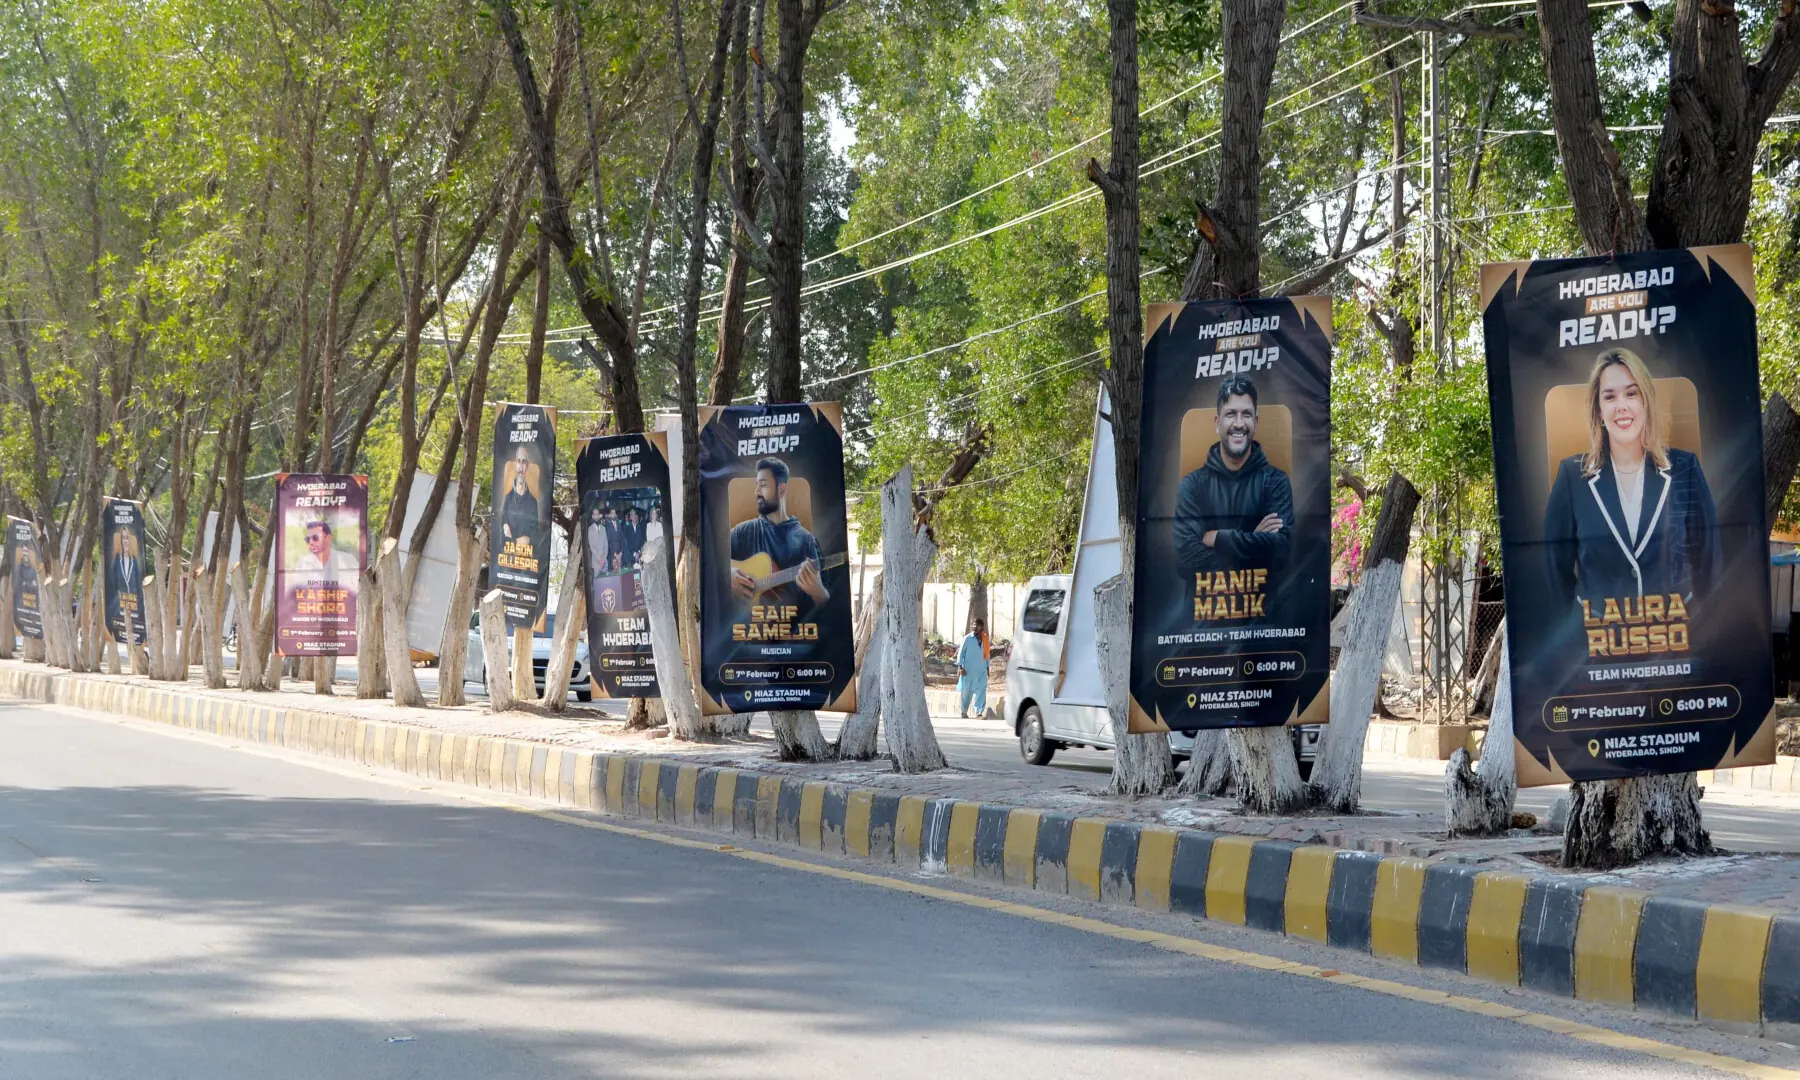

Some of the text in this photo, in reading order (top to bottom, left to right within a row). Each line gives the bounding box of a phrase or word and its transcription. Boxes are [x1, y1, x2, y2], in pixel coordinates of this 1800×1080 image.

[1559, 267, 1674, 299] HYDERABAD
[1589, 293, 1643, 312] ARE YOU
[1199, 315, 1280, 340] HYDERABAD
[1559, 305, 1676, 347] READY?
[1219, 335, 1258, 350] ARE YOU
[1195, 347, 1279, 378] READY?
[739, 413, 799, 429] HYDERABAD
[510, 430, 538, 442] READY?
[754, 429, 767, 437] ARE
[600, 444, 640, 460] HYDERABAD
[738, 435, 799, 456] READY?
[600, 463, 641, 482] READY?
[297, 483, 346, 491] HYDERABAD
[296, 496, 346, 507] READY?
[504, 541, 533, 557] JASON
[498, 553, 538, 573] GILLESPIE
[1195, 568, 1267, 596] HANIF
[296, 589, 348, 601] KASHIF
[297, 602, 346, 614] SHORO
[752, 605, 798, 622] SAIF
[1194, 594, 1266, 620] MALIK
[1582, 593, 1689, 626] LAURA
[617, 618, 645, 630] TEAM
[732, 623, 818, 641] SAMEJO
[603, 632, 653, 646] HYDERABA
[1158, 628, 1306, 645] BATTING COACH TEAM HYDERABAD
[1586, 623, 1689, 657] RUSSO
[1178, 666, 1234, 677] 7th February
[1257, 661, 1295, 671] 6:00 PM
[1588, 664, 1691, 681] TEAM HYDERABAD
[746, 671, 779, 679] February
[1201, 689, 1272, 702] NIAZ STADIUM
[1200, 702, 1239, 710] HYDERABAD,
[1572, 704, 1646, 720] 7th February
[1677, 697, 1727, 711] 6:00 PM
[1604, 732, 1700, 749] NIAZ STADIUM
[1605, 746, 1684, 759] HYDERABAD, SINDH
